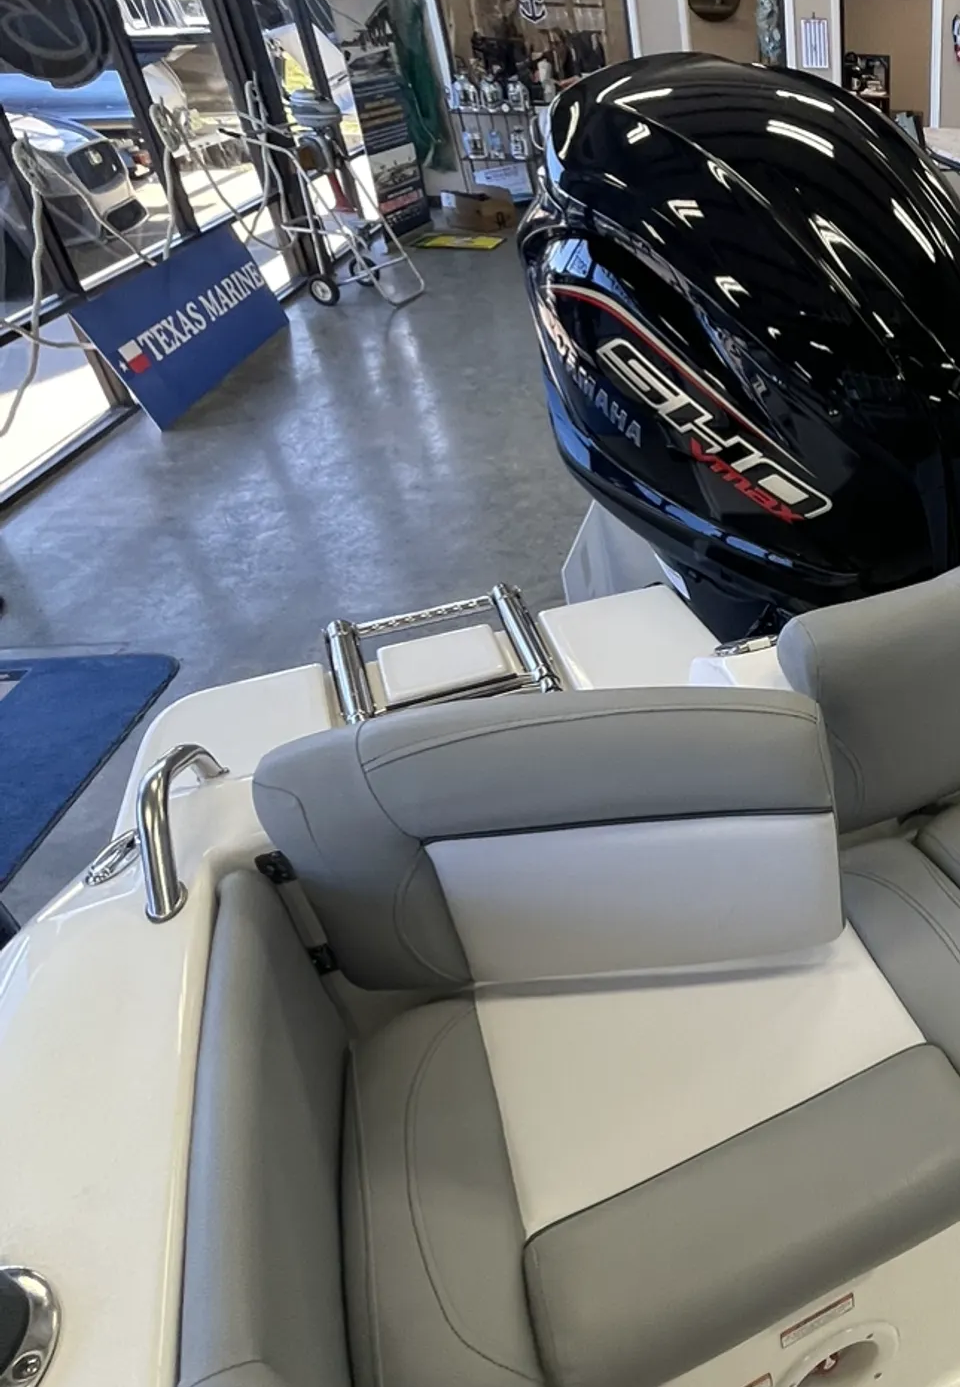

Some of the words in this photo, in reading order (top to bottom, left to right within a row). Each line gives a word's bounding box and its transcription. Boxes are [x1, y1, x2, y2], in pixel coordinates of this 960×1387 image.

[136, 301, 207, 362] TEXAS
[198, 262, 265, 322] MARINE
[596, 338, 833, 519] SHO
